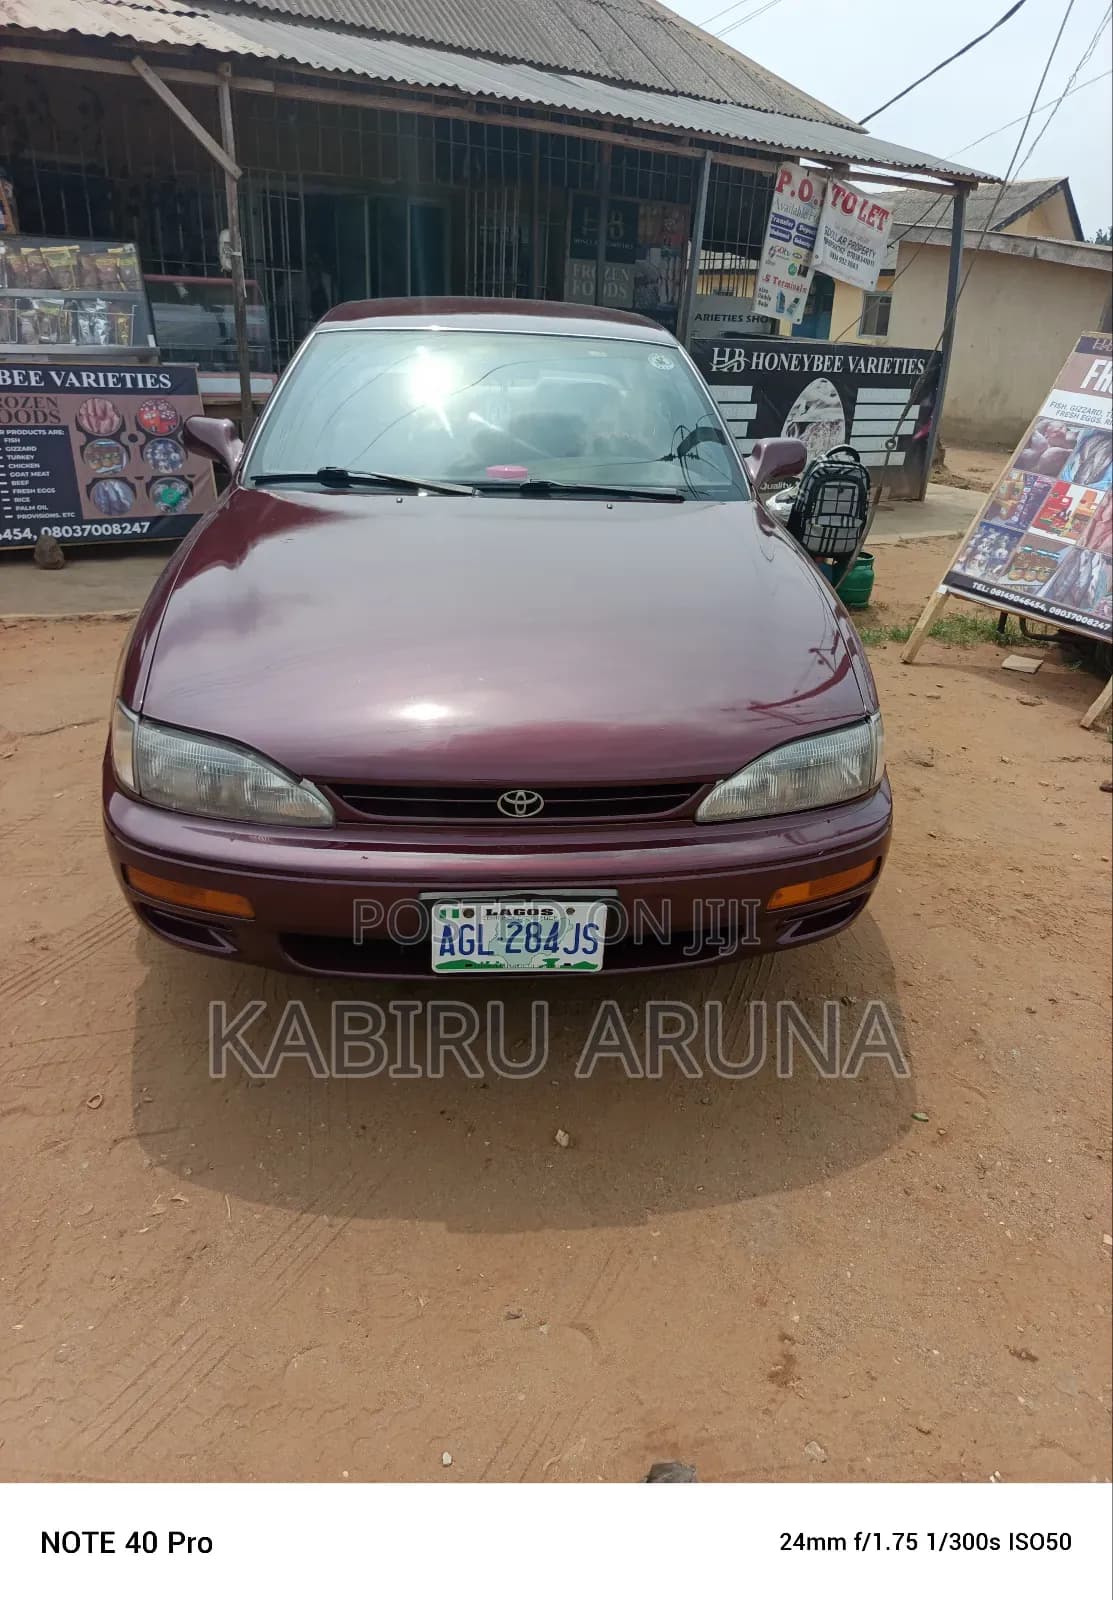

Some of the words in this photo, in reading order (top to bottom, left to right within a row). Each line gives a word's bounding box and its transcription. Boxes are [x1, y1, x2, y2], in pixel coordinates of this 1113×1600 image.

[831, 183, 858, 215] TO
[857, 198, 890, 232] LET
[751, 351, 843, 374] HONEYBEE
[848, 355, 926, 375] VARIETIES
[48, 370, 172, 388] VARIETIES
[1080, 358, 1112, 393] FR
[1056, 409, 1079, 420] FRESH
[760, 481, 792, 491] Quality
[0, 528, 37, 540] 454,
[41, 522, 150, 538] 08037008247
[972, 581, 988, 593] TEL:
[1049, 606, 1111, 631] 08037008247
[486, 908, 554, 916] LAGOS
[439, 923, 494, 956] AGL
